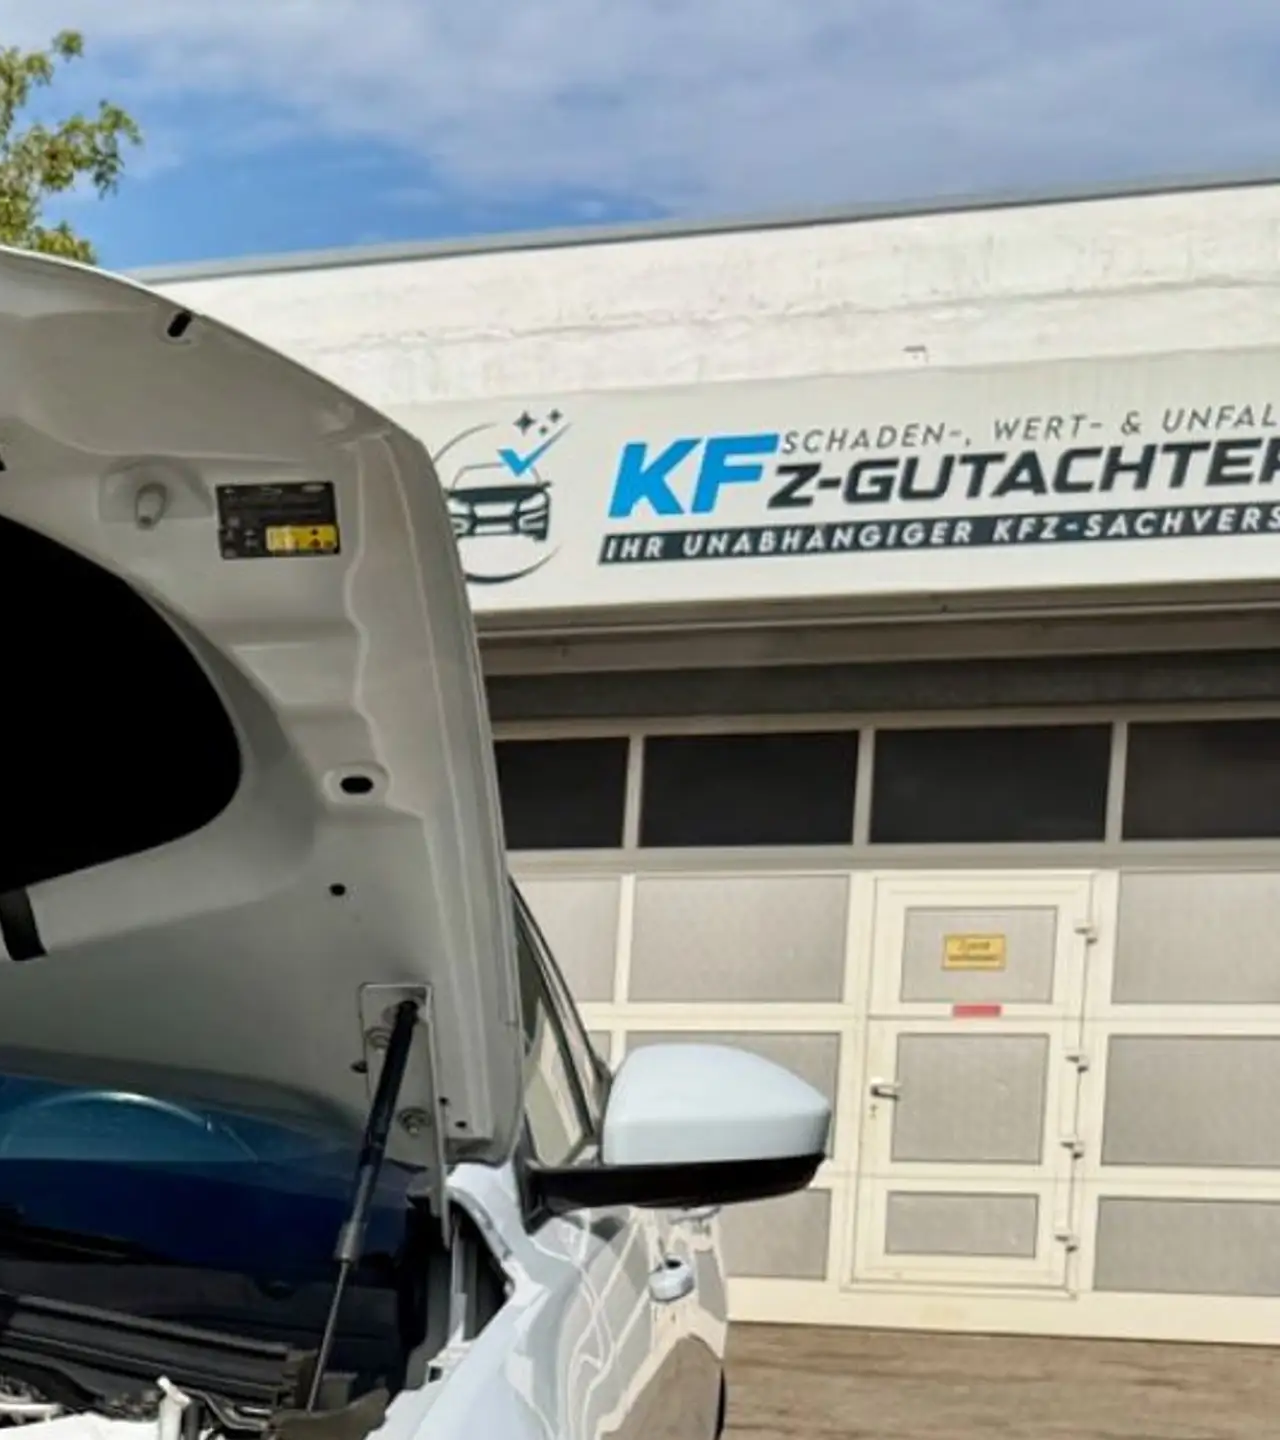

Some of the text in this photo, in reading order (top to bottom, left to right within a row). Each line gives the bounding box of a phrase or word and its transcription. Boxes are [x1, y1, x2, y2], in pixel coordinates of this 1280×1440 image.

[993, 413, 1103, 442] WERT-
[1120, 410, 1142, 436] &
[605, 537, 665, 561] IHR
